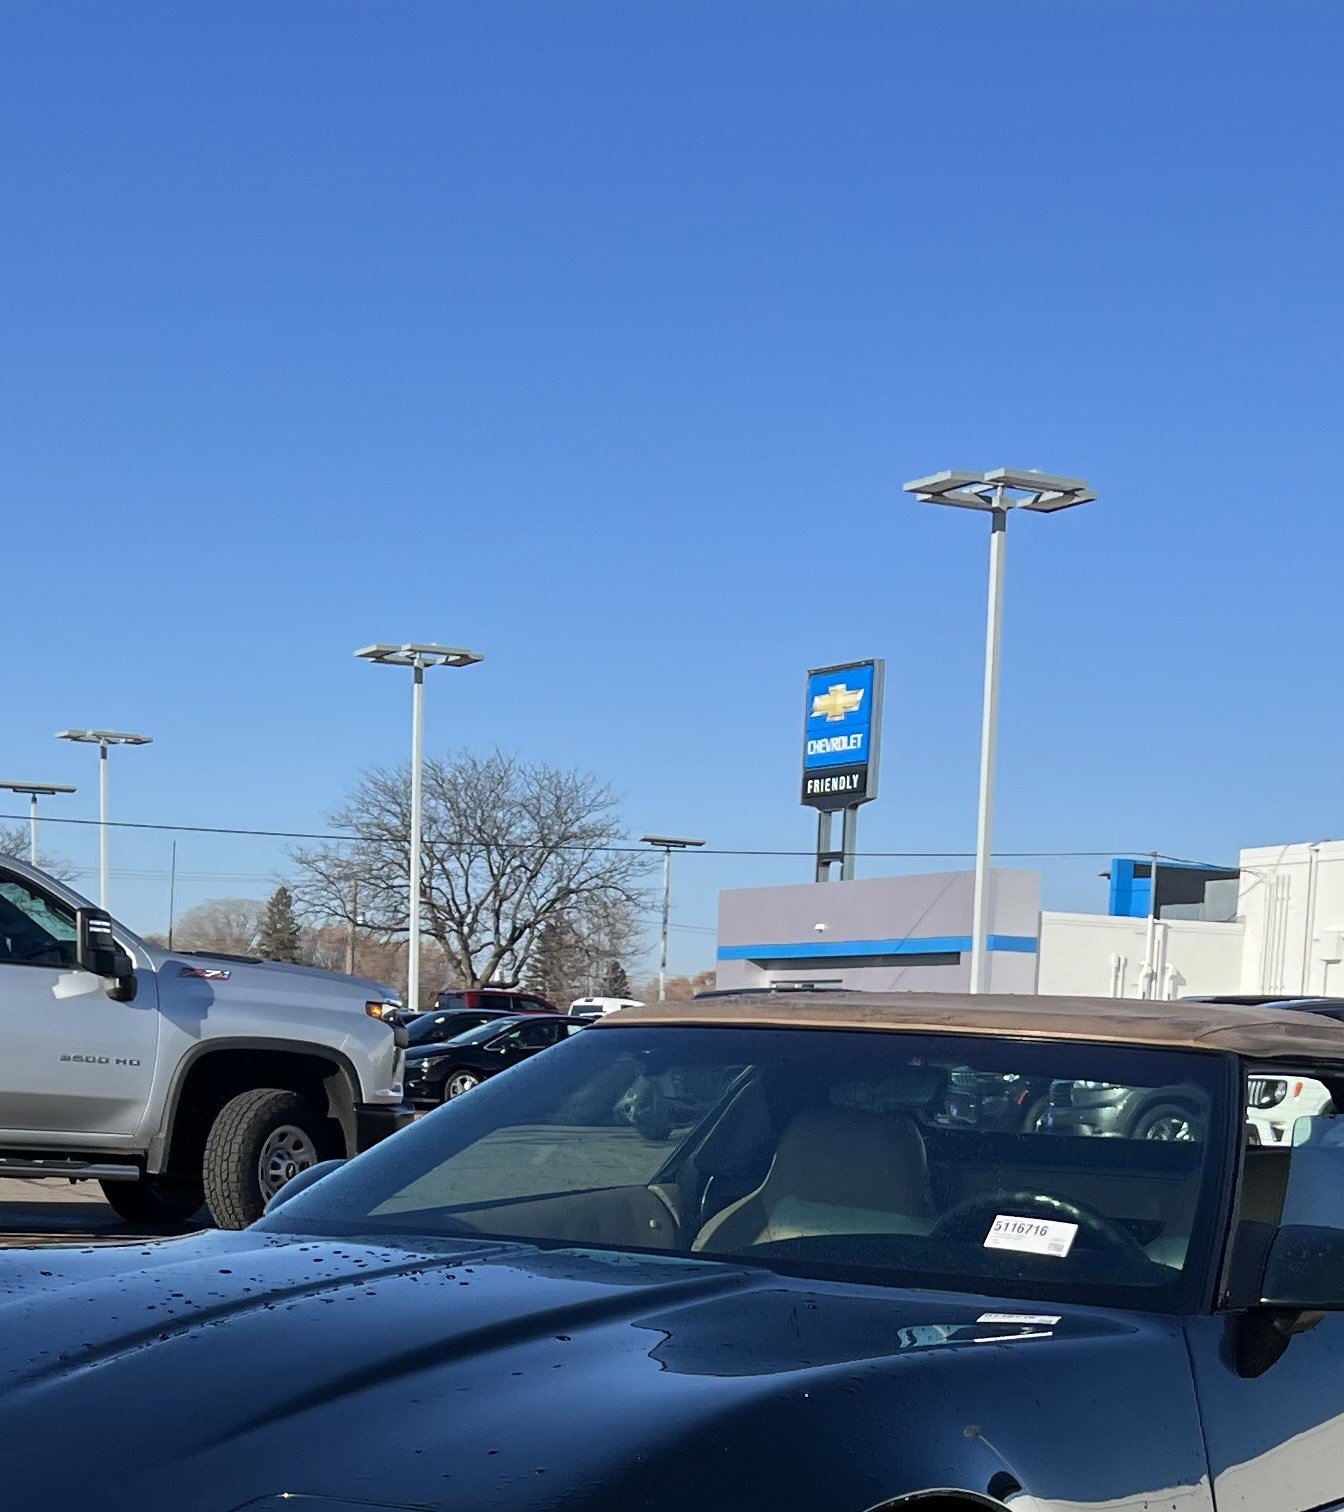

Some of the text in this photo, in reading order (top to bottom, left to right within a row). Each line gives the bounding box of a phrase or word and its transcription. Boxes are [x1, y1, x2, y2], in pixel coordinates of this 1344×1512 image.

[807, 733, 863, 755] CHEVROLET
[807, 774, 859, 794] FRIENDLY
[994, 1220, 1049, 1236] 5116716
